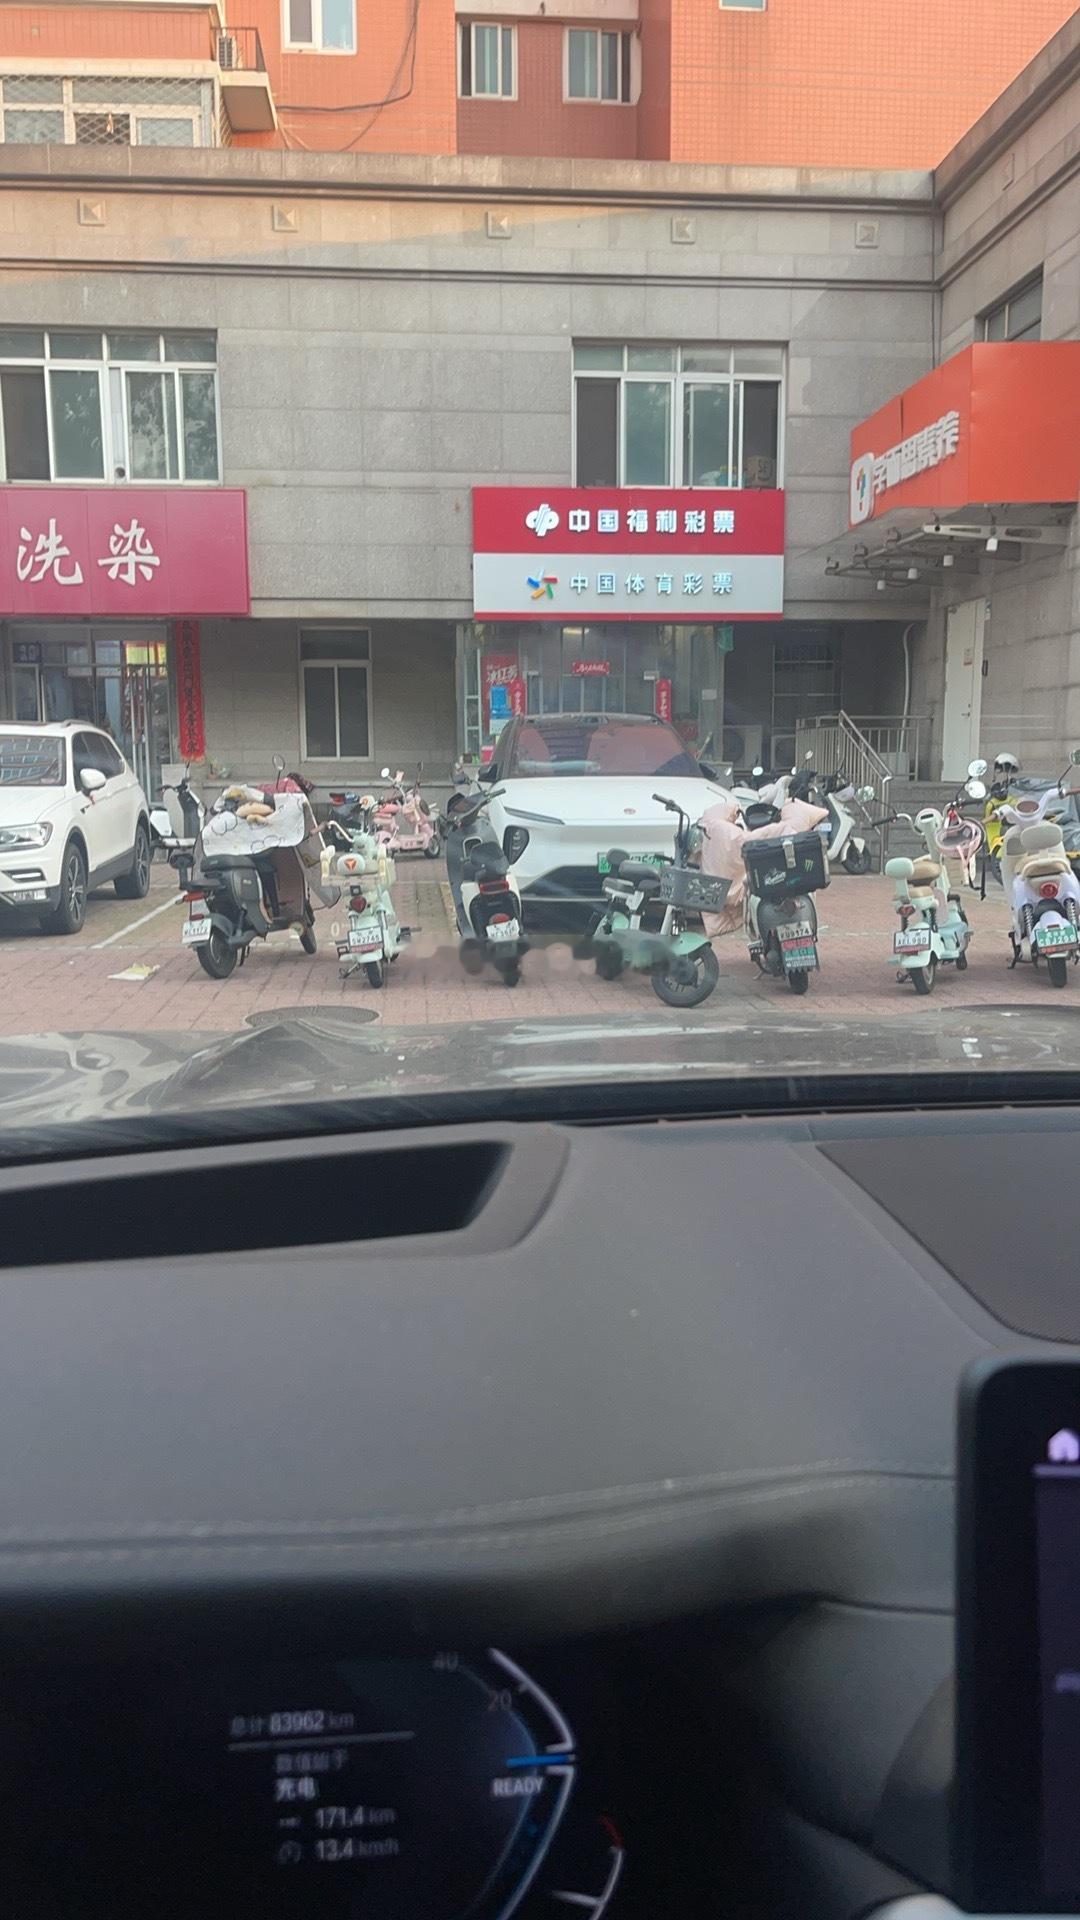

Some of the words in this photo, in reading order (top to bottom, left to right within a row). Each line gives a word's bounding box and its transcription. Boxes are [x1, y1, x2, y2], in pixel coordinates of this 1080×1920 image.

[568, 508, 736, 533] 中国福利彩票
[16, 517, 161, 586] 洗染
[569, 571, 733, 595] 中国体育彩票
[488, 1689, 513, 1712] 20
[270, 1710, 325, 1735] 83962
[328, 1712, 355, 1729] km
[275, 1777, 317, 1802] 充电
[492, 1776, 545, 1798] READY
[315, 1806, 365, 1828] 171.4
[368, 1807, 396, 1824] km
[315, 1837, 355, 1861] 13.4
